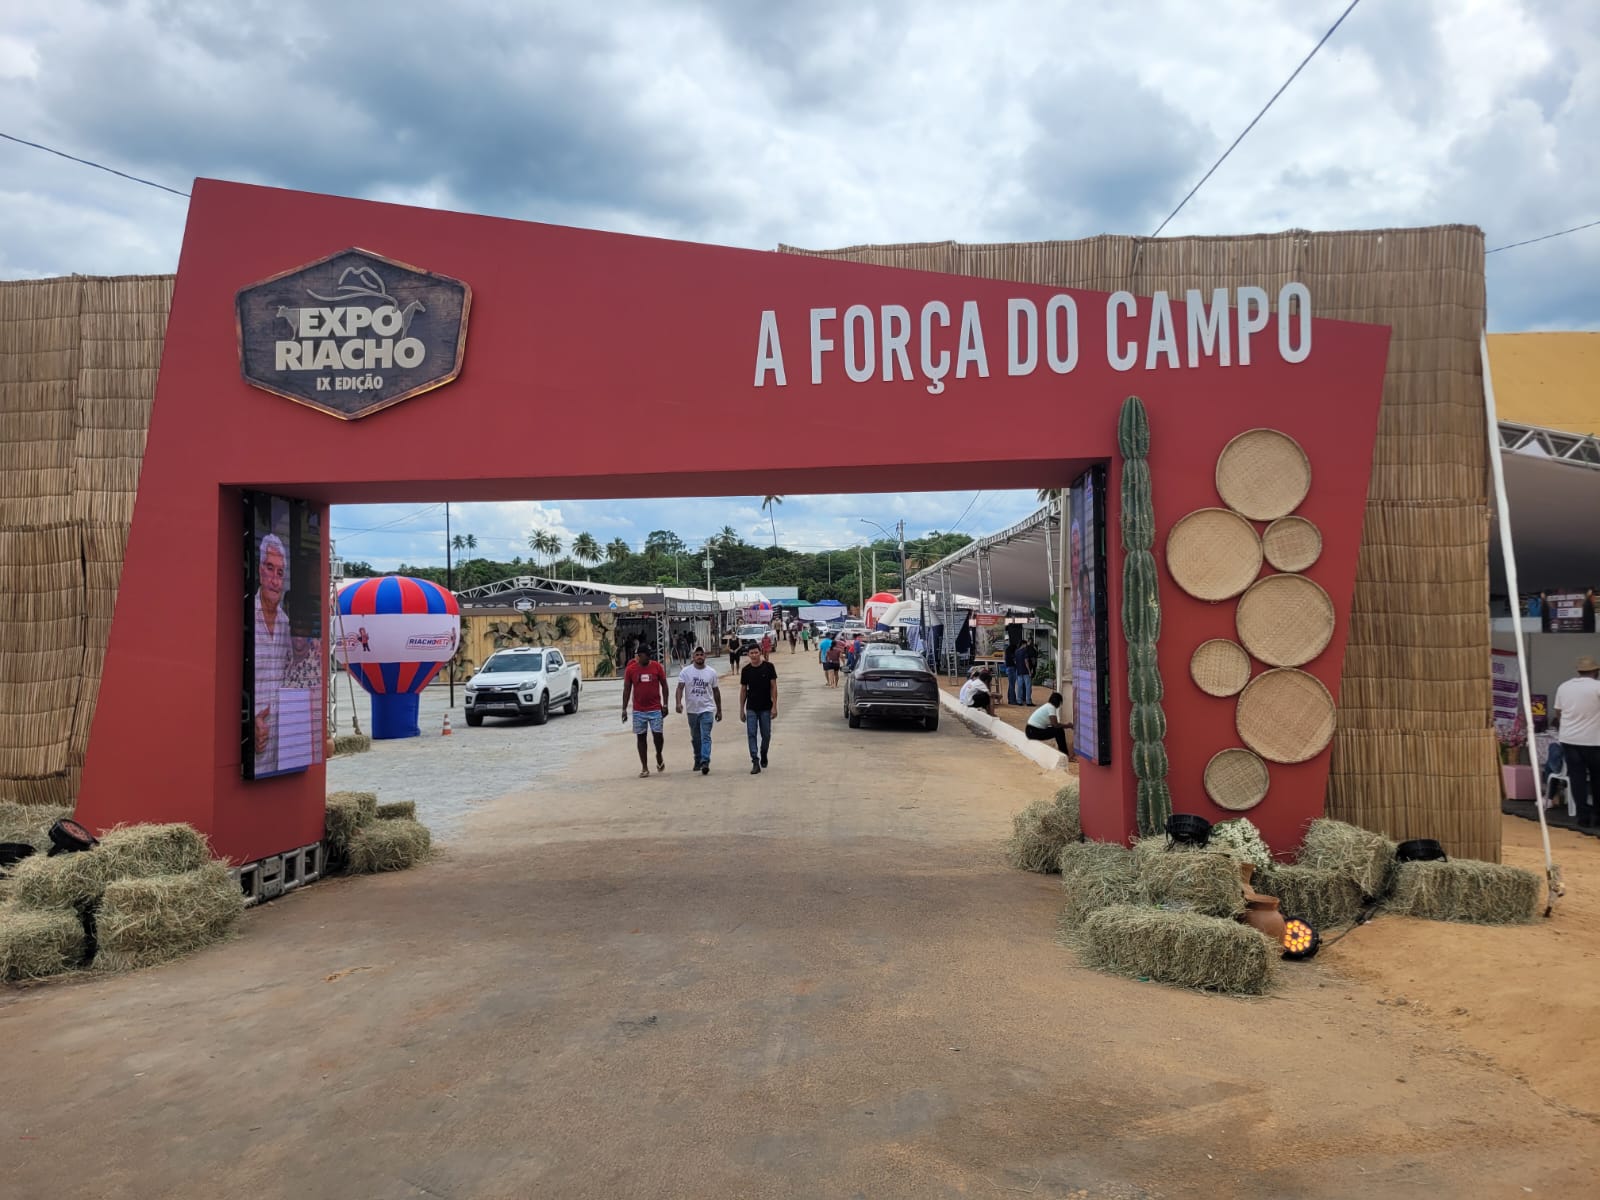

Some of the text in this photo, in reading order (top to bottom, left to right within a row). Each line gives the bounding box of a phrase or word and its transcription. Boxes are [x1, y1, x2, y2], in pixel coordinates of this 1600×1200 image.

[299, 305, 402, 338] EXPO
[275, 338, 426, 371] RIACHO
[753, 282, 1312, 395] A FORÇA DO CAMPO
[316, 373, 384, 393] IX EDIÇÃO
